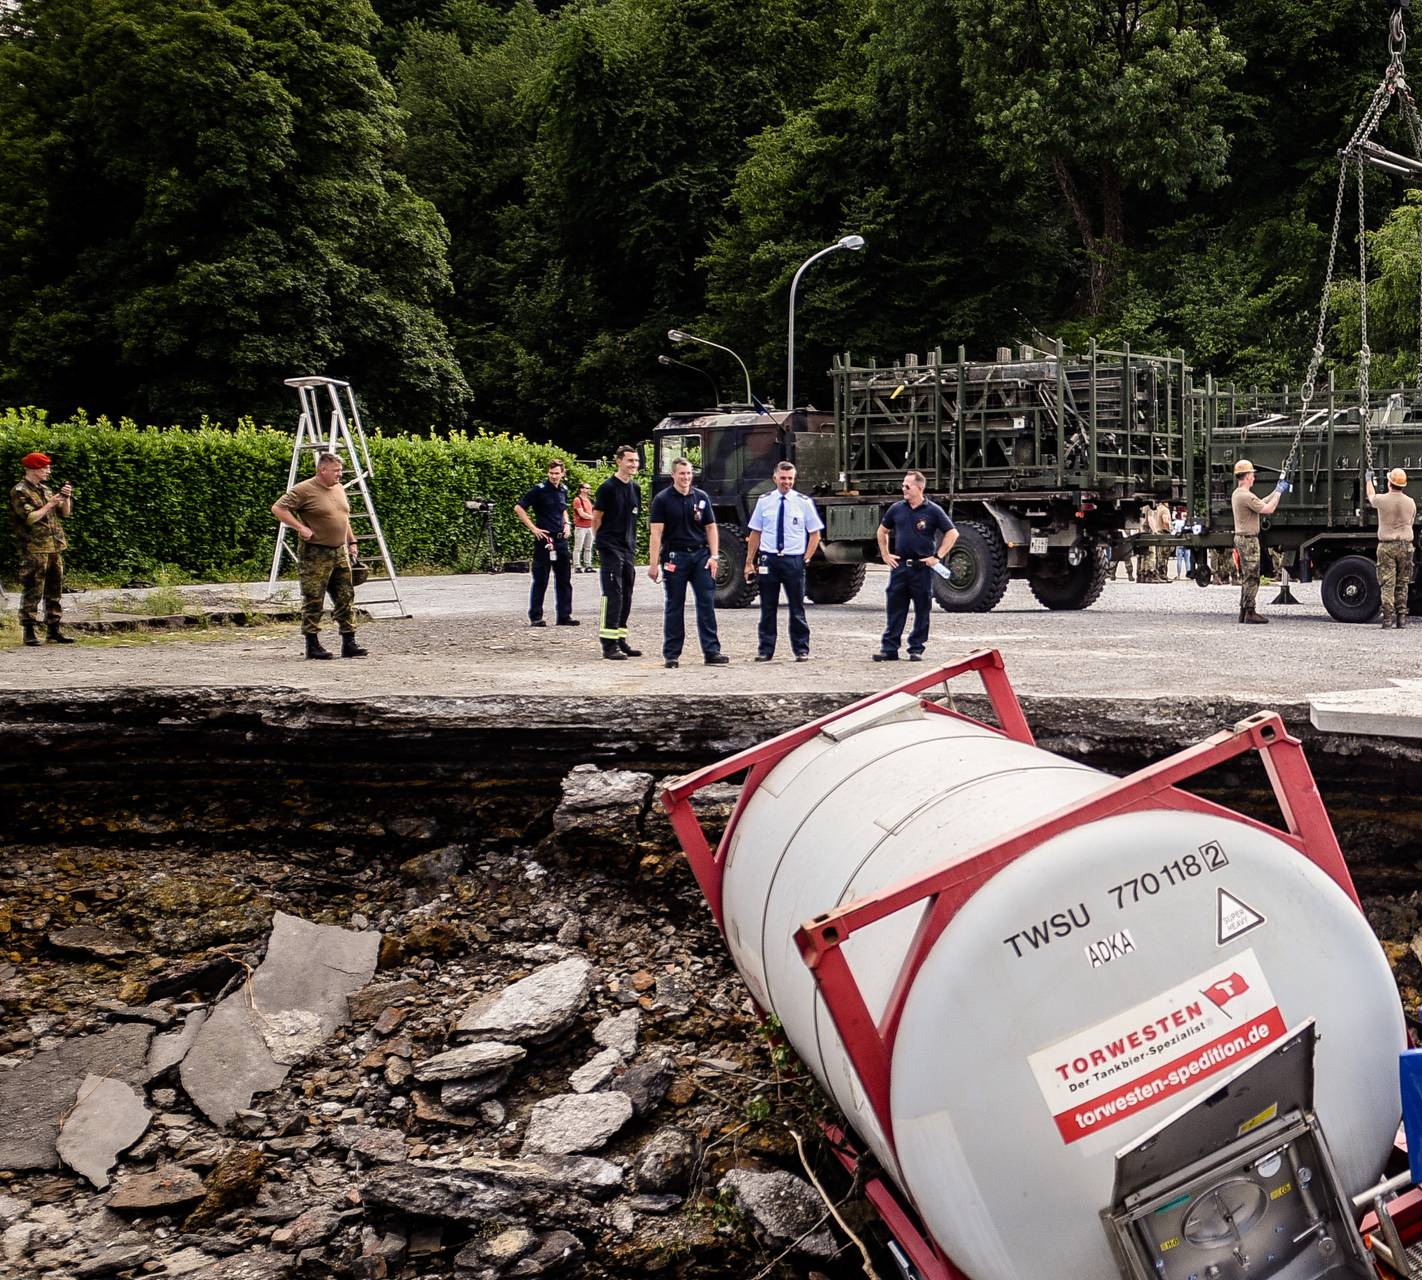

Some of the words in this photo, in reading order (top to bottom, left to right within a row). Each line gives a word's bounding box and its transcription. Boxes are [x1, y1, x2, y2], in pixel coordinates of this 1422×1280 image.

[1003, 903, 1091, 959] TWSU
[1203, 844, 1226, 869] 2
[1087, 930, 1136, 968] ADKA
[1215, 979, 1235, 997] T
[1055, 1001, 1204, 1081] TORWESTEN
[1068, 1079, 1090, 1093] Der
[1092, 1021, 1207, 1082] Tankbier-Spezialist
[1075, 1022, 1270, 1129] torwesten-spedition.de
